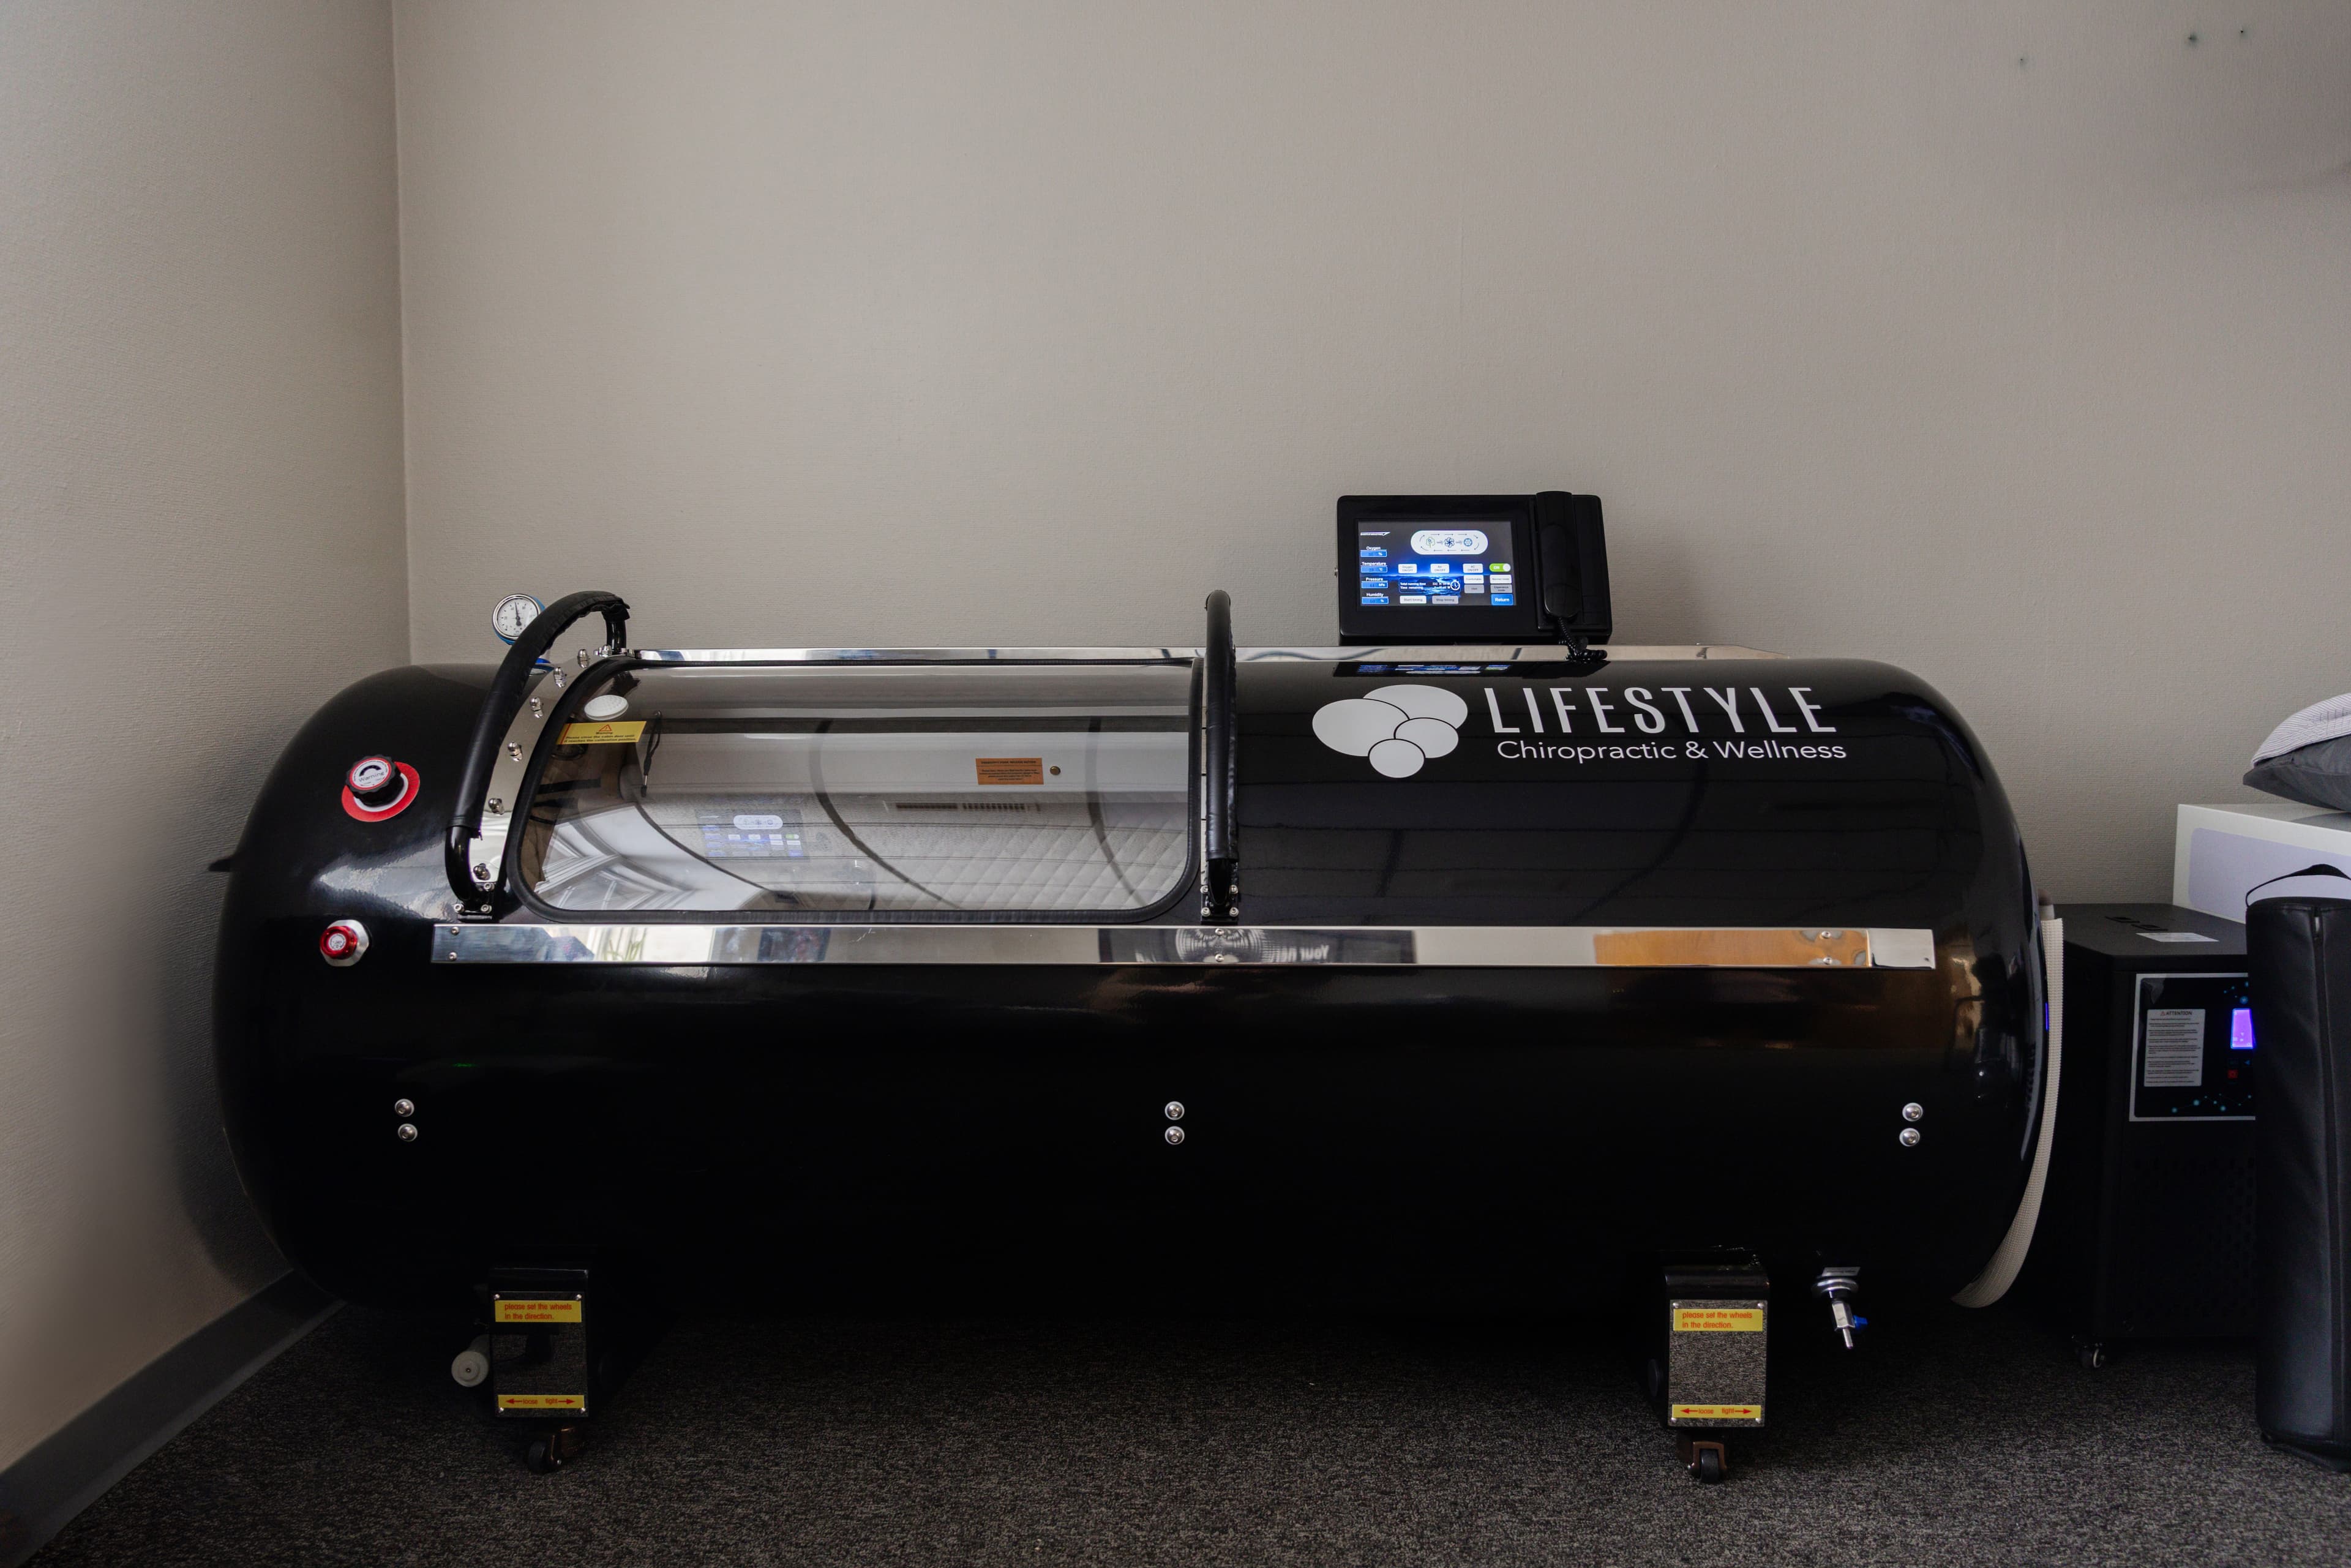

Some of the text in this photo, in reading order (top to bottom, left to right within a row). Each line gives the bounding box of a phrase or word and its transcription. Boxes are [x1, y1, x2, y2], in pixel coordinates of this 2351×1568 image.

[1484, 688, 1836, 733] LIFESTYLE
[1498, 740, 1846, 763] Chiropractic & Wellness
[359, 771, 384, 782] Warning
